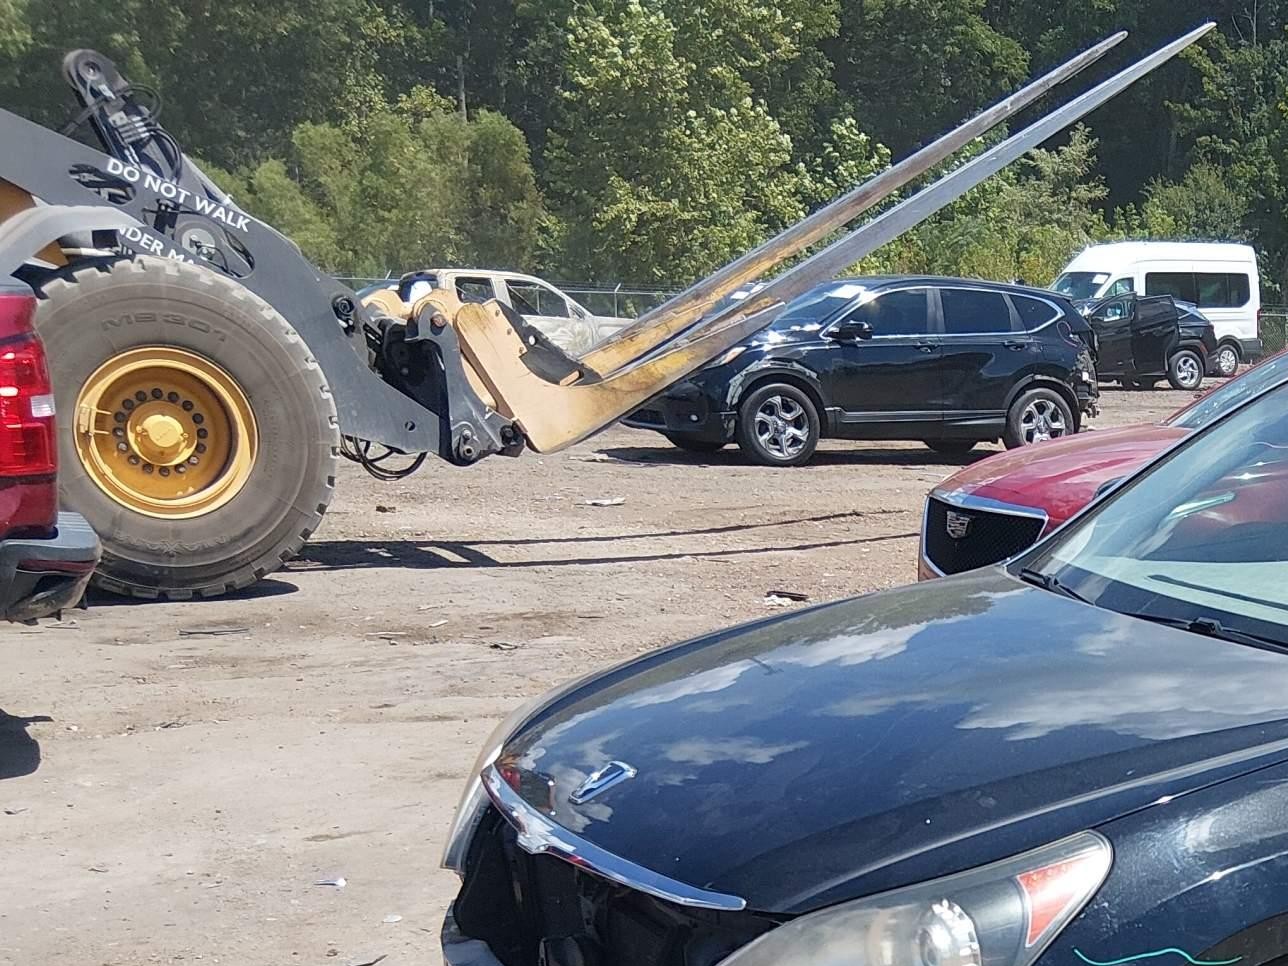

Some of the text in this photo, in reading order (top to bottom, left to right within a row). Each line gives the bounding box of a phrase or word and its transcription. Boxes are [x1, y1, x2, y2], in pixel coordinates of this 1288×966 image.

[107, 157, 251, 232] DO NOT WALK
[118, 225, 164, 256] NDER
